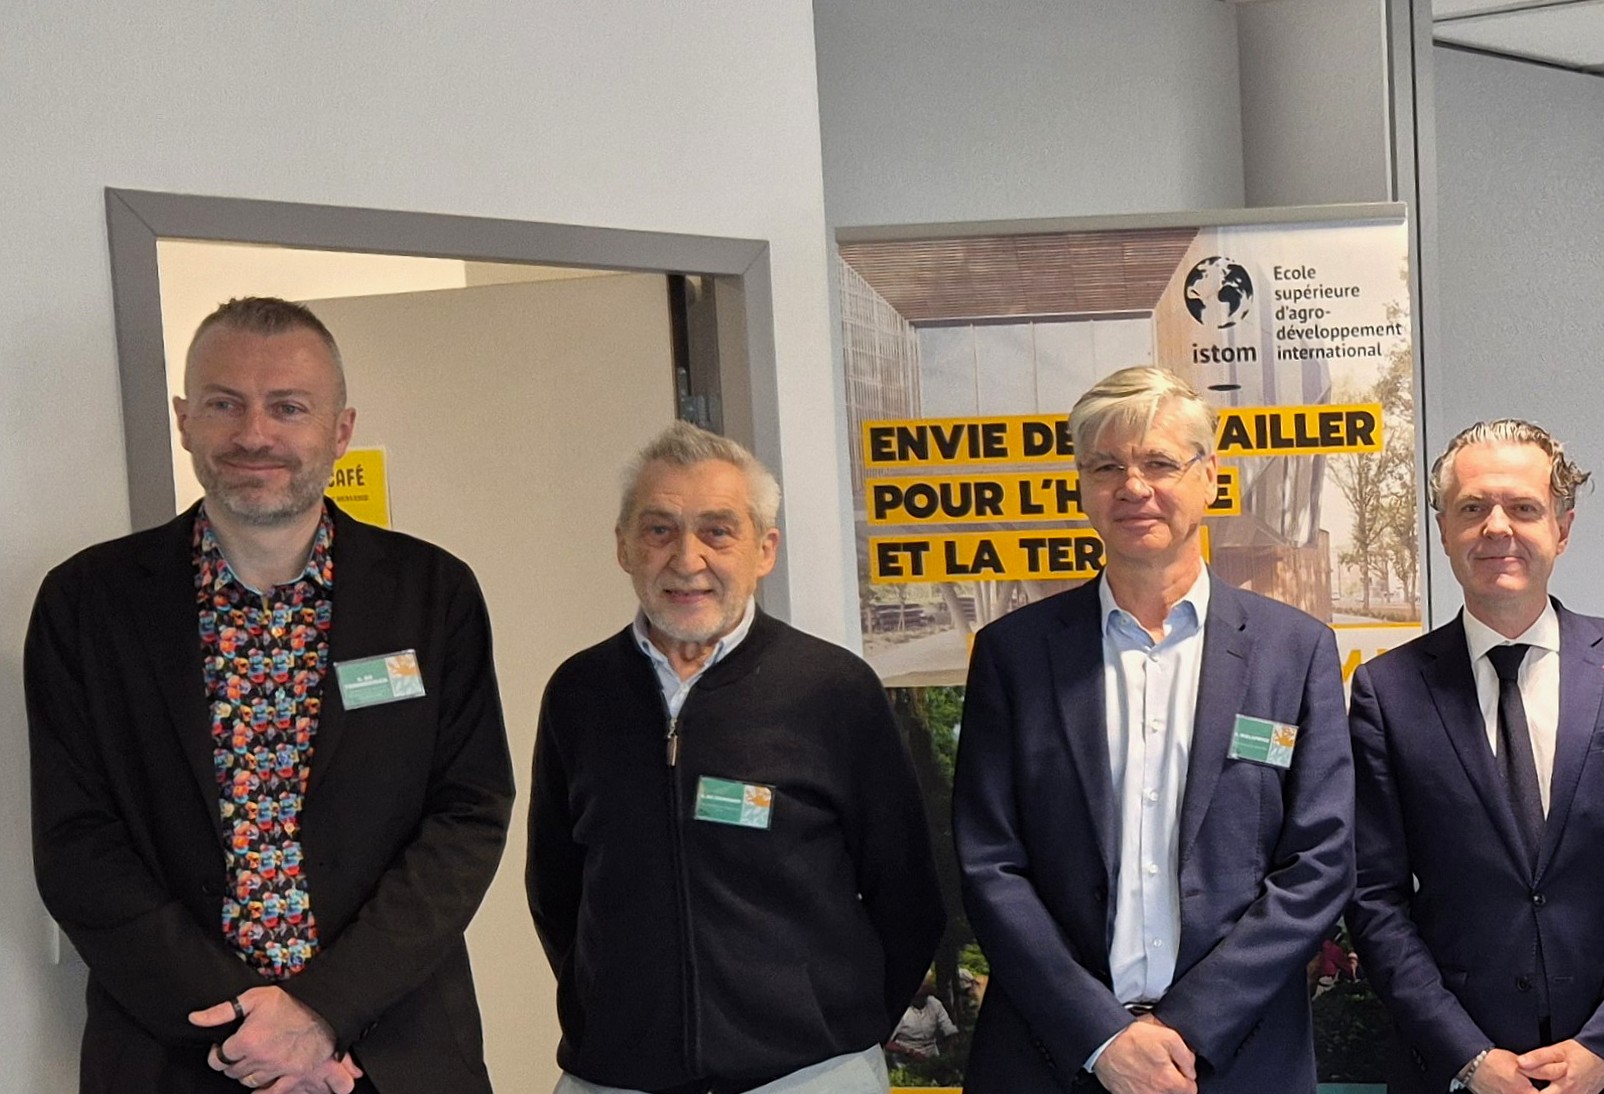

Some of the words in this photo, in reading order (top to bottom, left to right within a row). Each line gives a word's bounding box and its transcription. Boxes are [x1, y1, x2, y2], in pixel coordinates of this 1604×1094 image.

[1274, 266, 1316, 281] Ecole
[1275, 284, 1360, 304] supérieure
[1276, 306, 1331, 323] d'agro-
[1277, 323, 1403, 343] développement
[1193, 343, 1257, 364] istom
[1277, 342, 1382, 361] international
[870, 423, 1008, 462] ENVIE
[1022, 421, 1076, 457] DE
[1217, 410, 1376, 451] AILLER
[873, 481, 1005, 520] POUR
[877, 541, 931, 577] ET
[944, 540, 1006, 575] LA
[1019, 536, 1106, 572] TER
